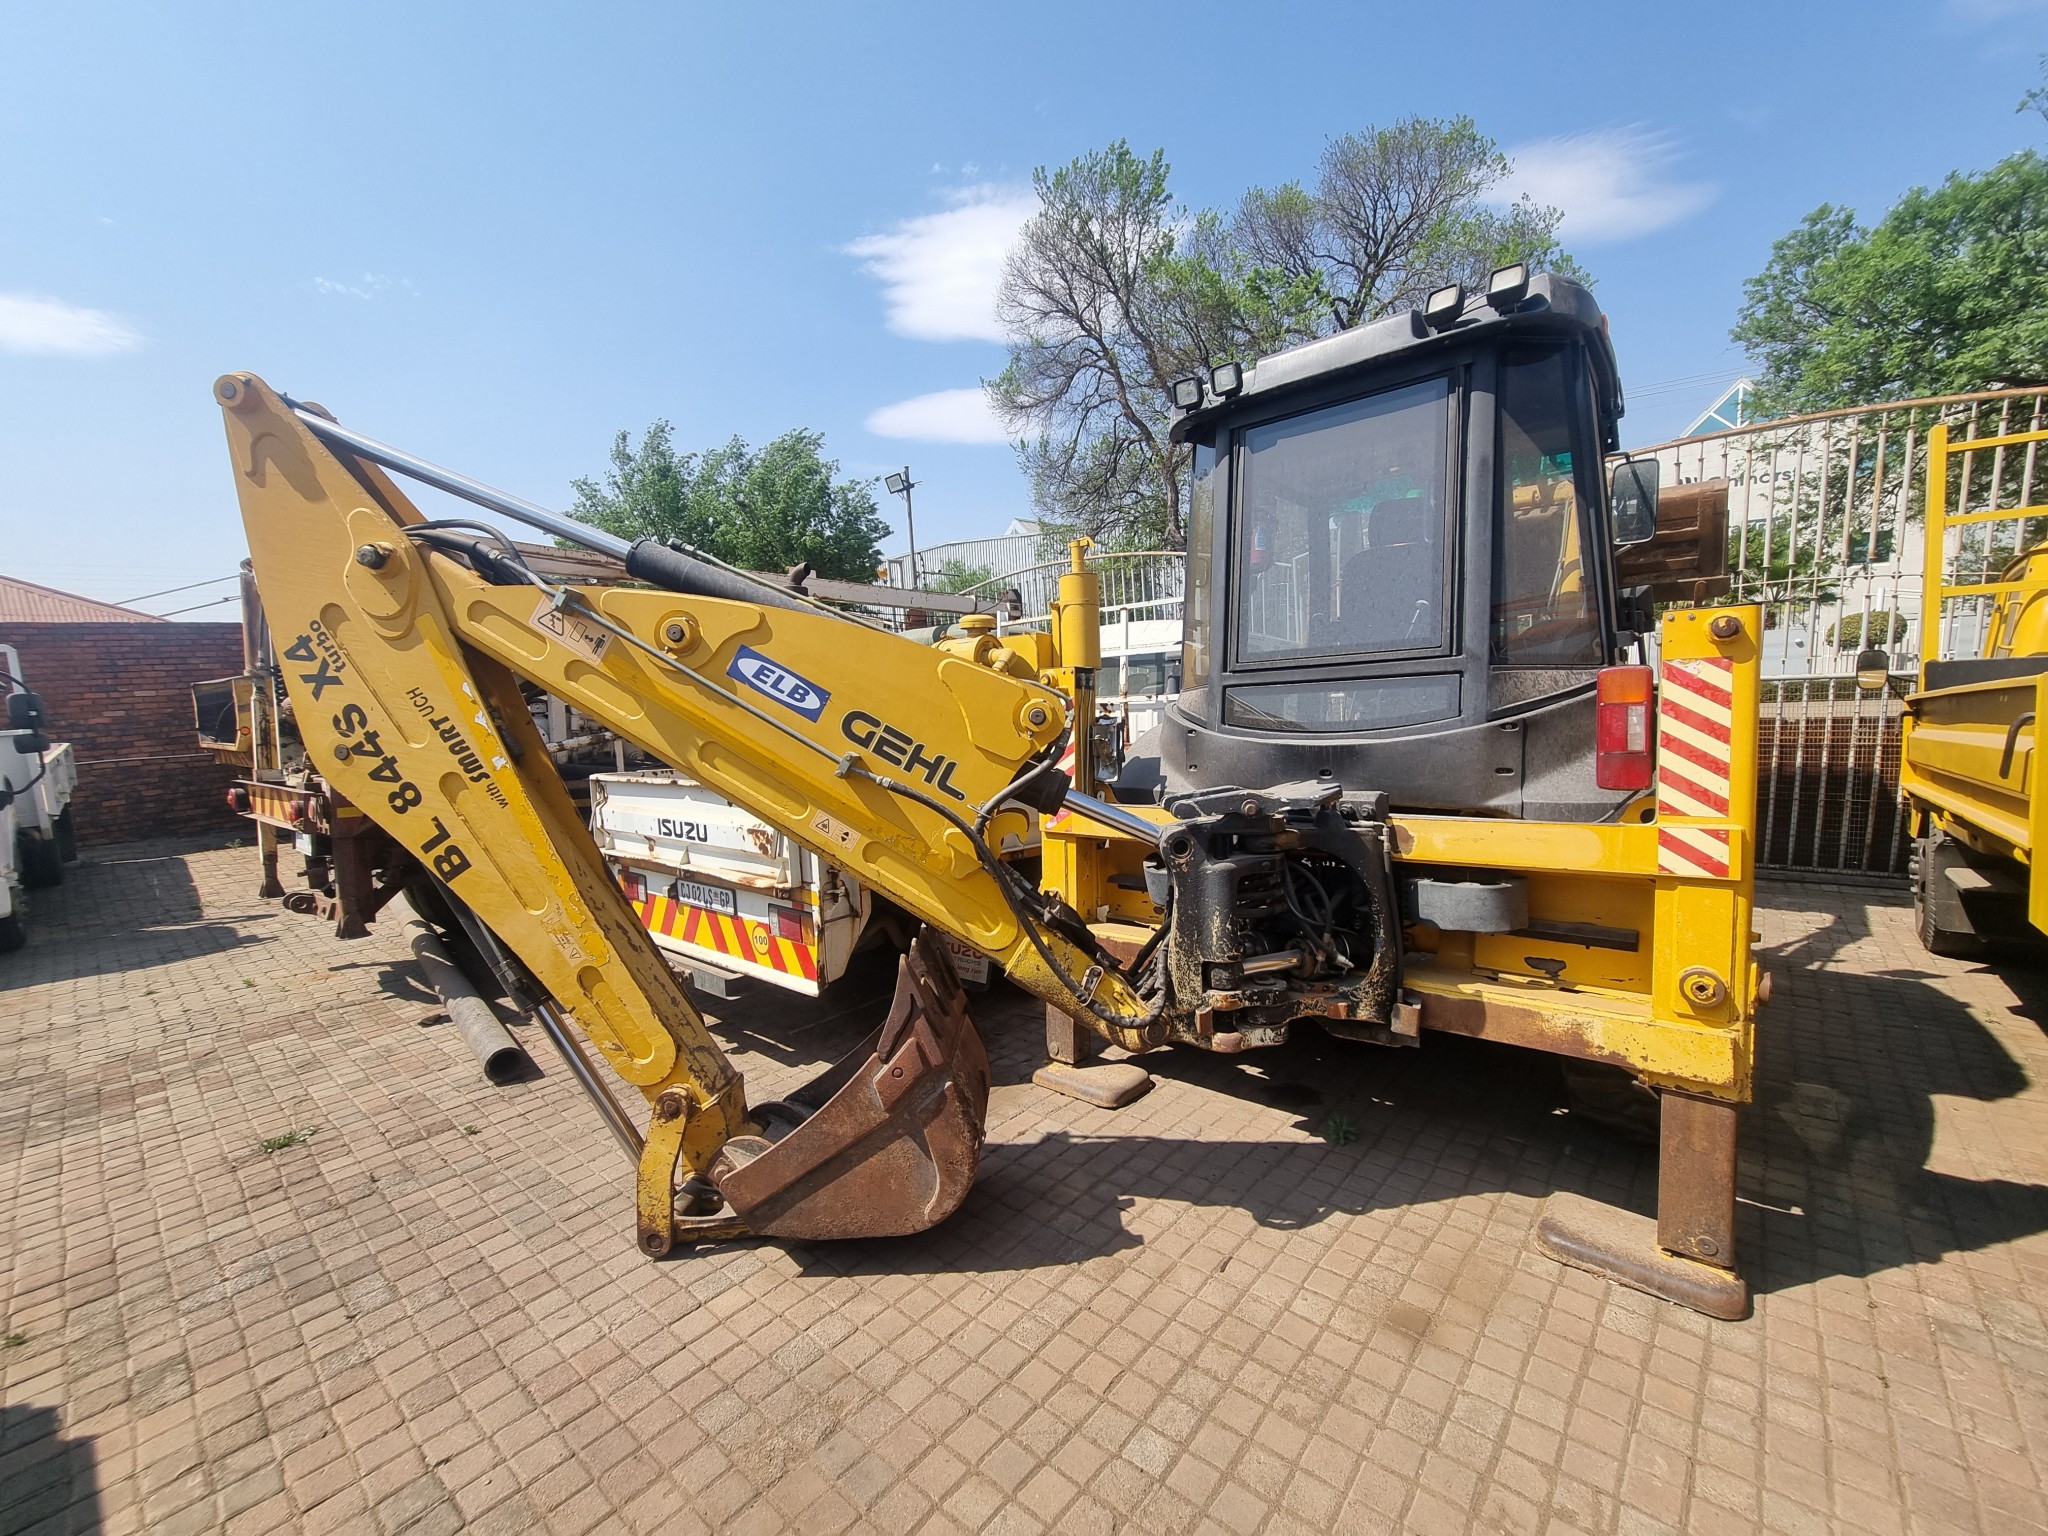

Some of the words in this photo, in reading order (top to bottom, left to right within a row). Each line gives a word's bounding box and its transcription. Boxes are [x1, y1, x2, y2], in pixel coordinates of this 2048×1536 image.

[309, 619, 347, 673] turbo
[282, 634, 344, 702] X4
[750, 662, 812, 704] ELB
[406, 686, 435, 717] UCH
[332, 703, 423, 815] 844S
[428, 716, 491, 783] SMART
[841, 709, 966, 801] GEHL
[485, 781, 509, 809] with
[656, 817, 708, 843] ISUZU
[420, 816, 473, 884] BL
[719, 889, 730, 909] GP
[754, 936, 768, 946] 100
[945, 941, 982, 959] UZU
[957, 965, 970, 974] long
